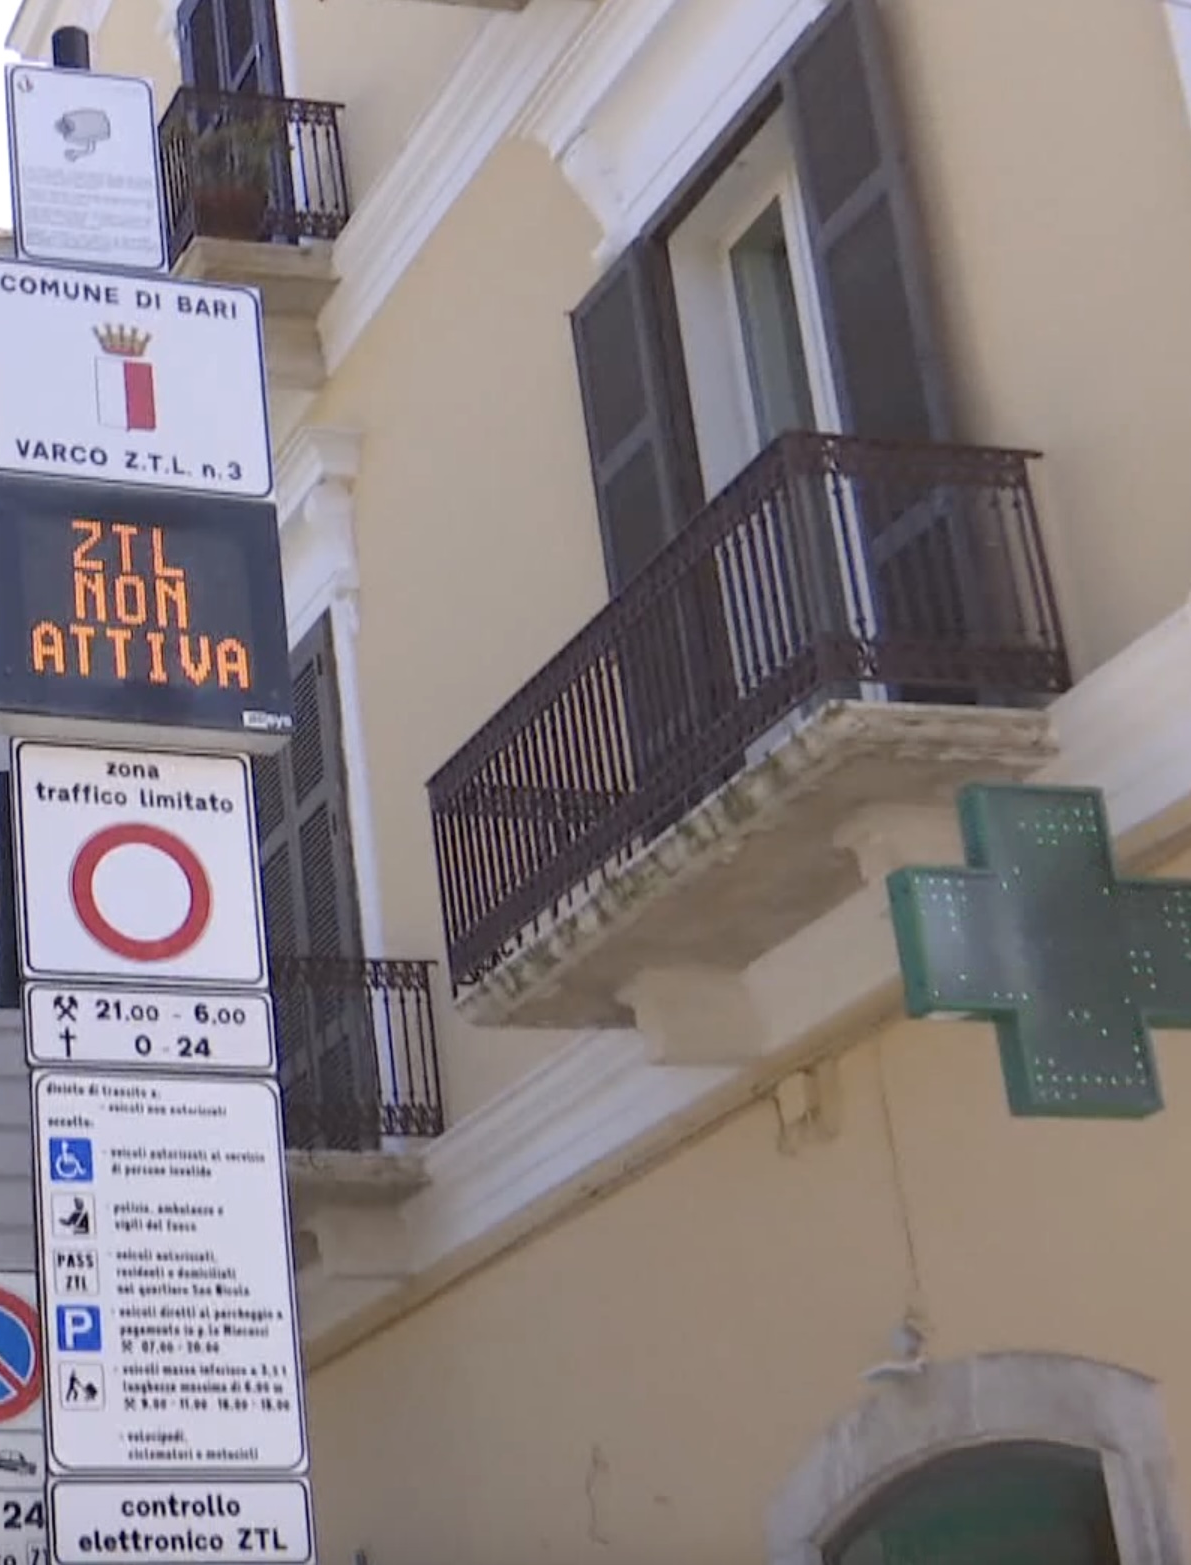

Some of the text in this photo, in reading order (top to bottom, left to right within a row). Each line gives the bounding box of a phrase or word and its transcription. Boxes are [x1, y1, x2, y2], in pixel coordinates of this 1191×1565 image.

[0, 274, 238, 320] COMUNE DI BARI
[16, 438, 108, 467] VARCO
[125, 452, 192, 476] Z.T.L.
[71, 519, 185, 580] ZTL
[74, 570, 189, 629] NON
[32, 620, 251, 691] ATTIVA
[106, 761, 159, 780] zona
[36, 782, 233, 814] traffico limitato
[96, 999, 159, 1022] 21.00
[194, 1005, 246, 1024] 6.00
[134, 1035, 151, 1056] 0
[176, 1037, 212, 1058] 24
[88, 1084, 99, 1097] di
[103, 1082, 146, 1099] transito
[109, 1102, 144, 1116] veicoli
[110, 1146, 146, 1159] veicoli
[150, 1148, 208, 1162] autorizzati
[225, 1150, 266, 1164] servizio
[111, 1162, 122, 1176] di
[124, 1164, 166, 1178] persone
[115, 1217, 197, 1234] vigili del fuoco
[57, 1253, 94, 1269] PASS
[116, 1248, 152, 1262] veicoli
[116, 1265, 164, 1280] residenti
[178, 1266, 236, 1281] domiciliati
[66, 1275, 87, 1293] ZTL
[138, 1283, 188, 1299] quartiere
[192, 1283, 212, 1297] San
[215, 1284, 250, 1297] Nicola
[119, 1305, 156, 1318] veicoli
[160, 1305, 196, 1320] diretti
[214, 1306, 274, 1322] parcheggio
[64, 1310, 93, 1349] P
[119, 1323, 180, 1338] pagamento
[123, 1363, 159, 1376] veicoli
[123, 1380, 176, 1396] lunghezza
[180, 1380, 227, 1394] massima
[128, 1448, 193, 1461] ciclomotori
[206, 1448, 259, 1461] motocicli
[3, 1500, 44, 1529] 24
[121, 1495, 241, 1519] controllo
[78, 1526, 289, 1555] elettronico ZTL
